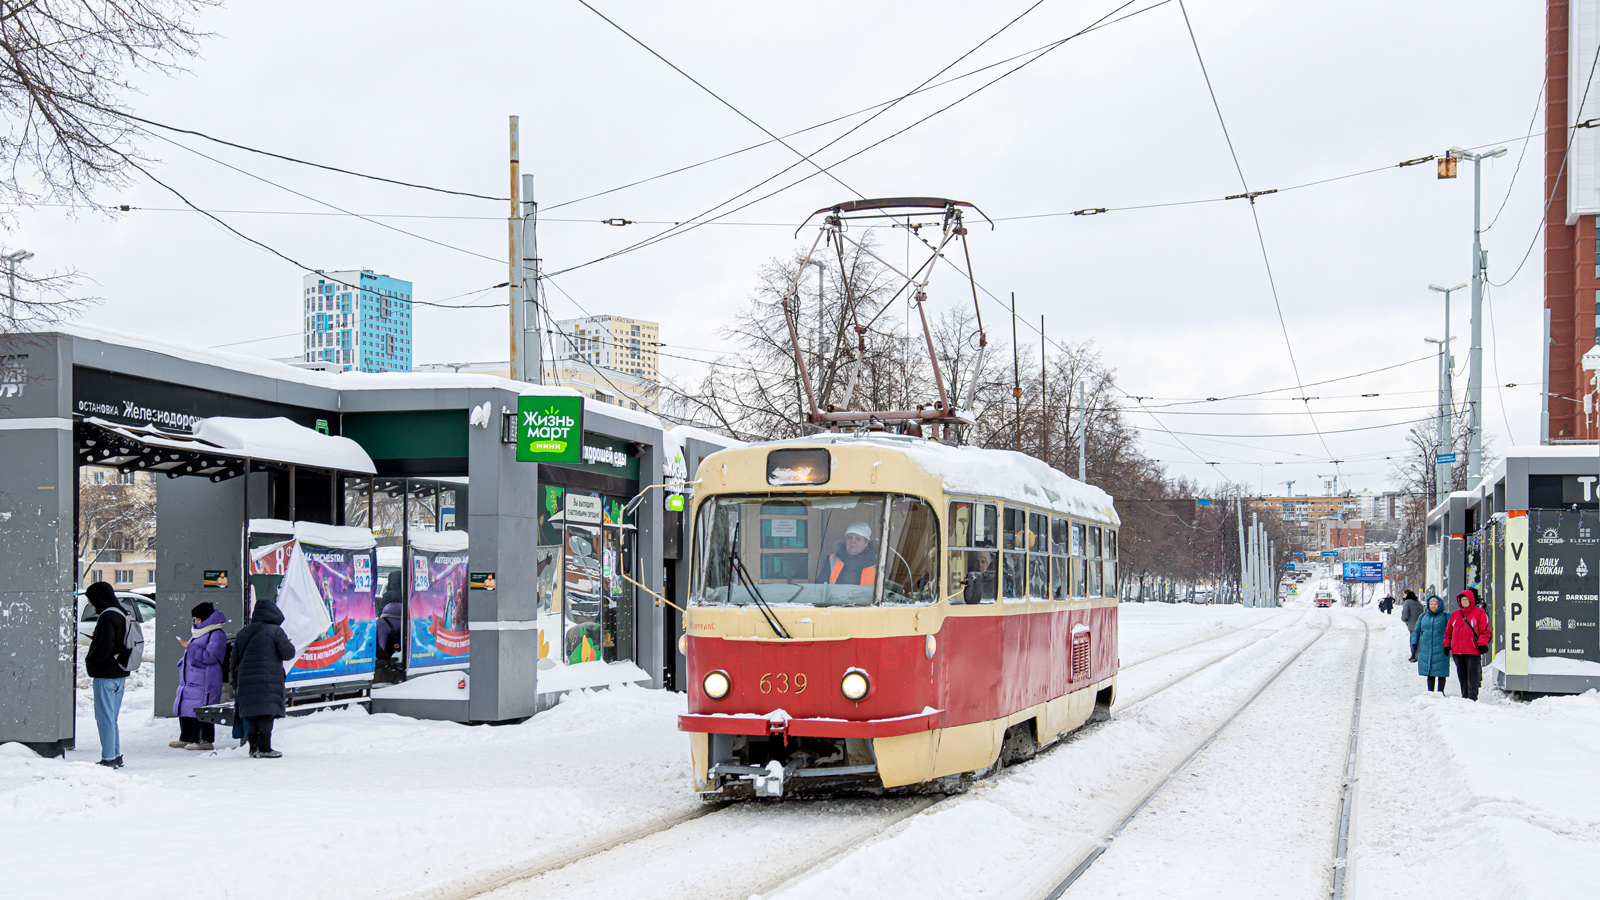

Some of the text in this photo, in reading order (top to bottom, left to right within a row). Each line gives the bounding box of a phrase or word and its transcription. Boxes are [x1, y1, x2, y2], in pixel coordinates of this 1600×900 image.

[78, 400, 199, 429] ОСТАНОВКА Железнодоро
[523, 411, 575, 427] Жизнь
[613, 451, 627, 467] еды
[1539, 557, 1560, 566] DAILY
[1534, 566, 1564, 575] HOOKAH
[1510, 542, 1525, 652] VAPE
[759, 673, 808, 695] 639
